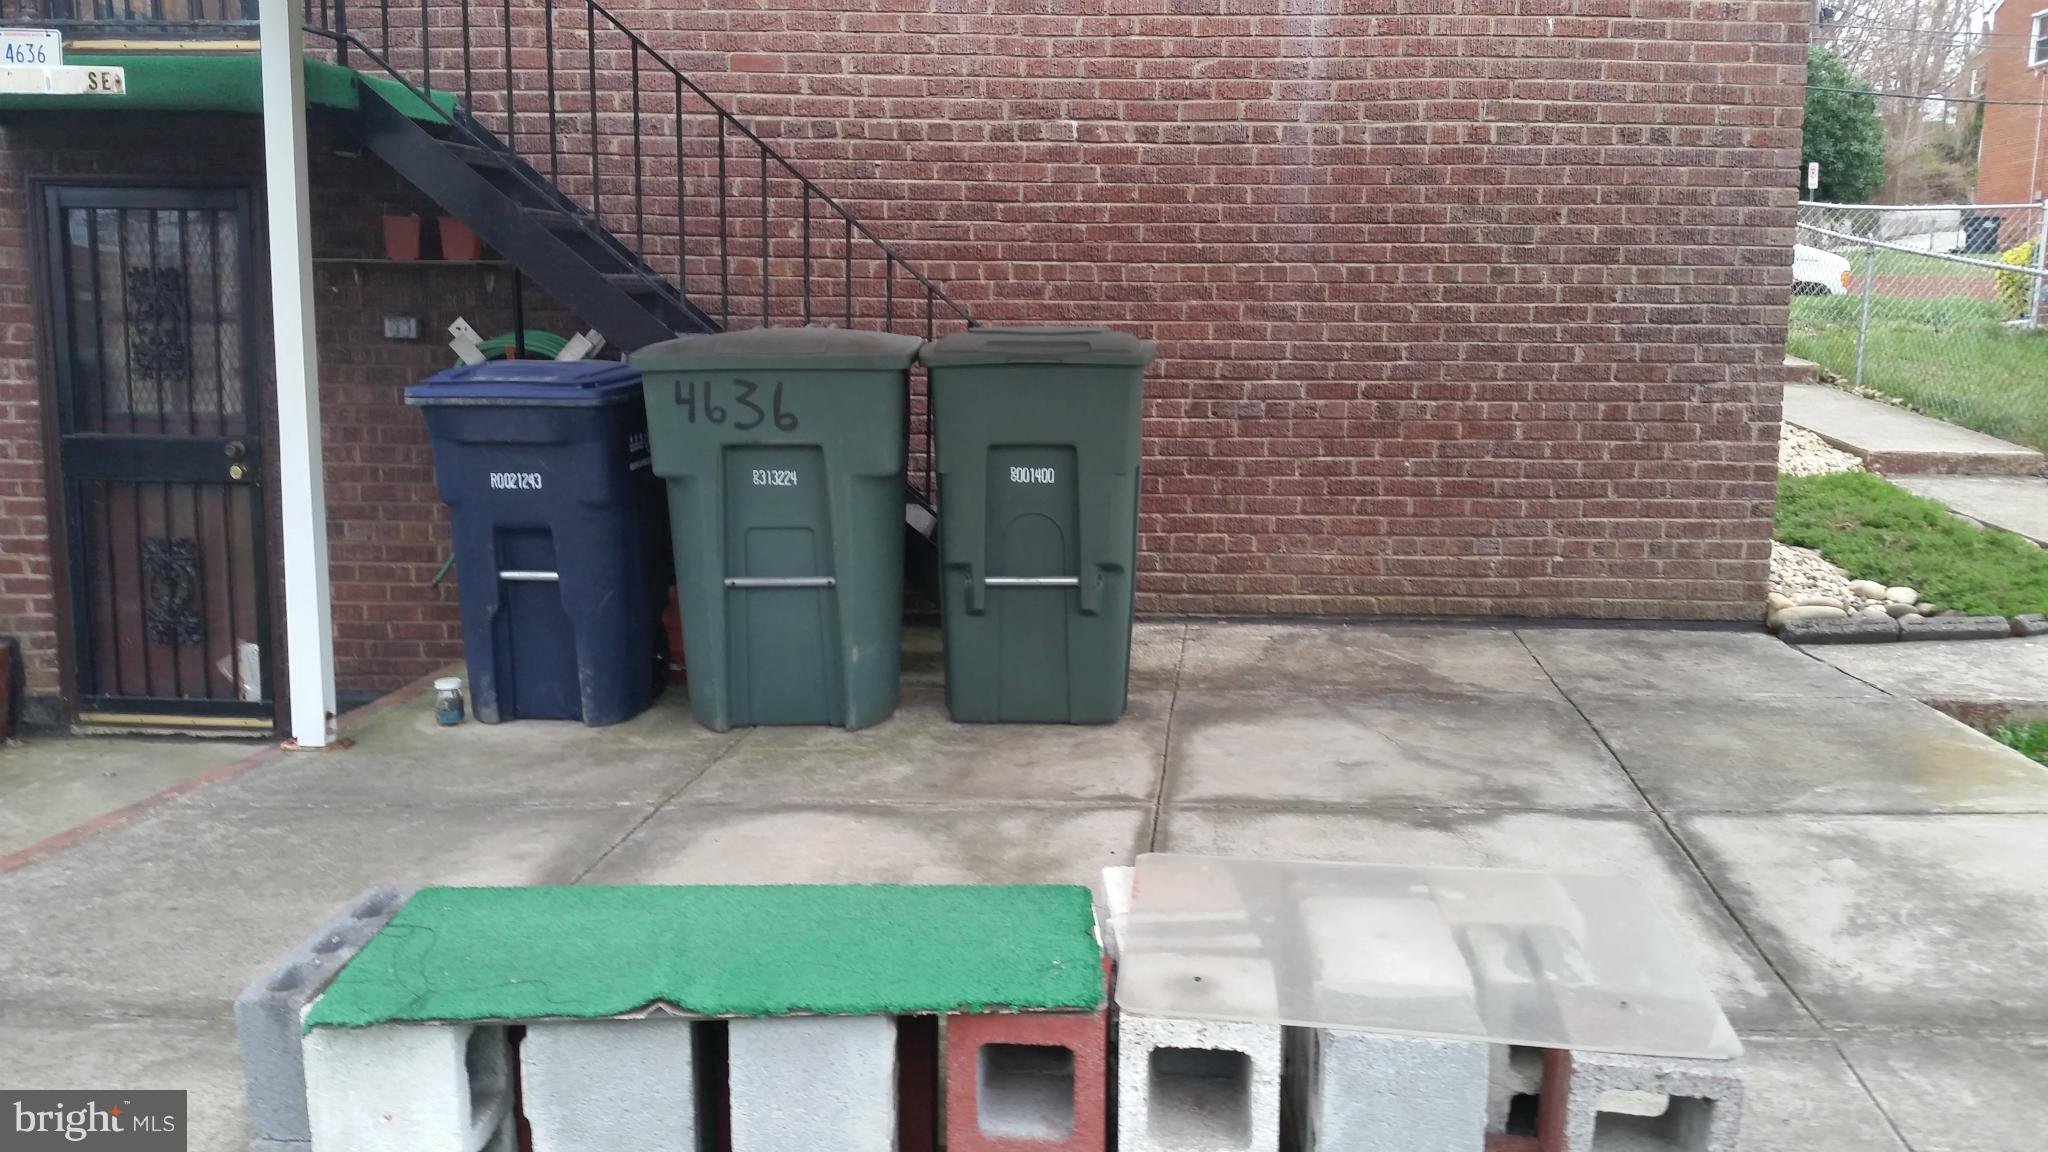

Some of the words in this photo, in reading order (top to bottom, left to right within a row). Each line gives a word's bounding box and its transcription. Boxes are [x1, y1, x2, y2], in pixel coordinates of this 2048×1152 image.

[6, 43, 46, 63] 4636
[88, 71, 111, 91] SE
[675, 378, 798, 432] 4636
[490, 472, 543, 490] R0021243
